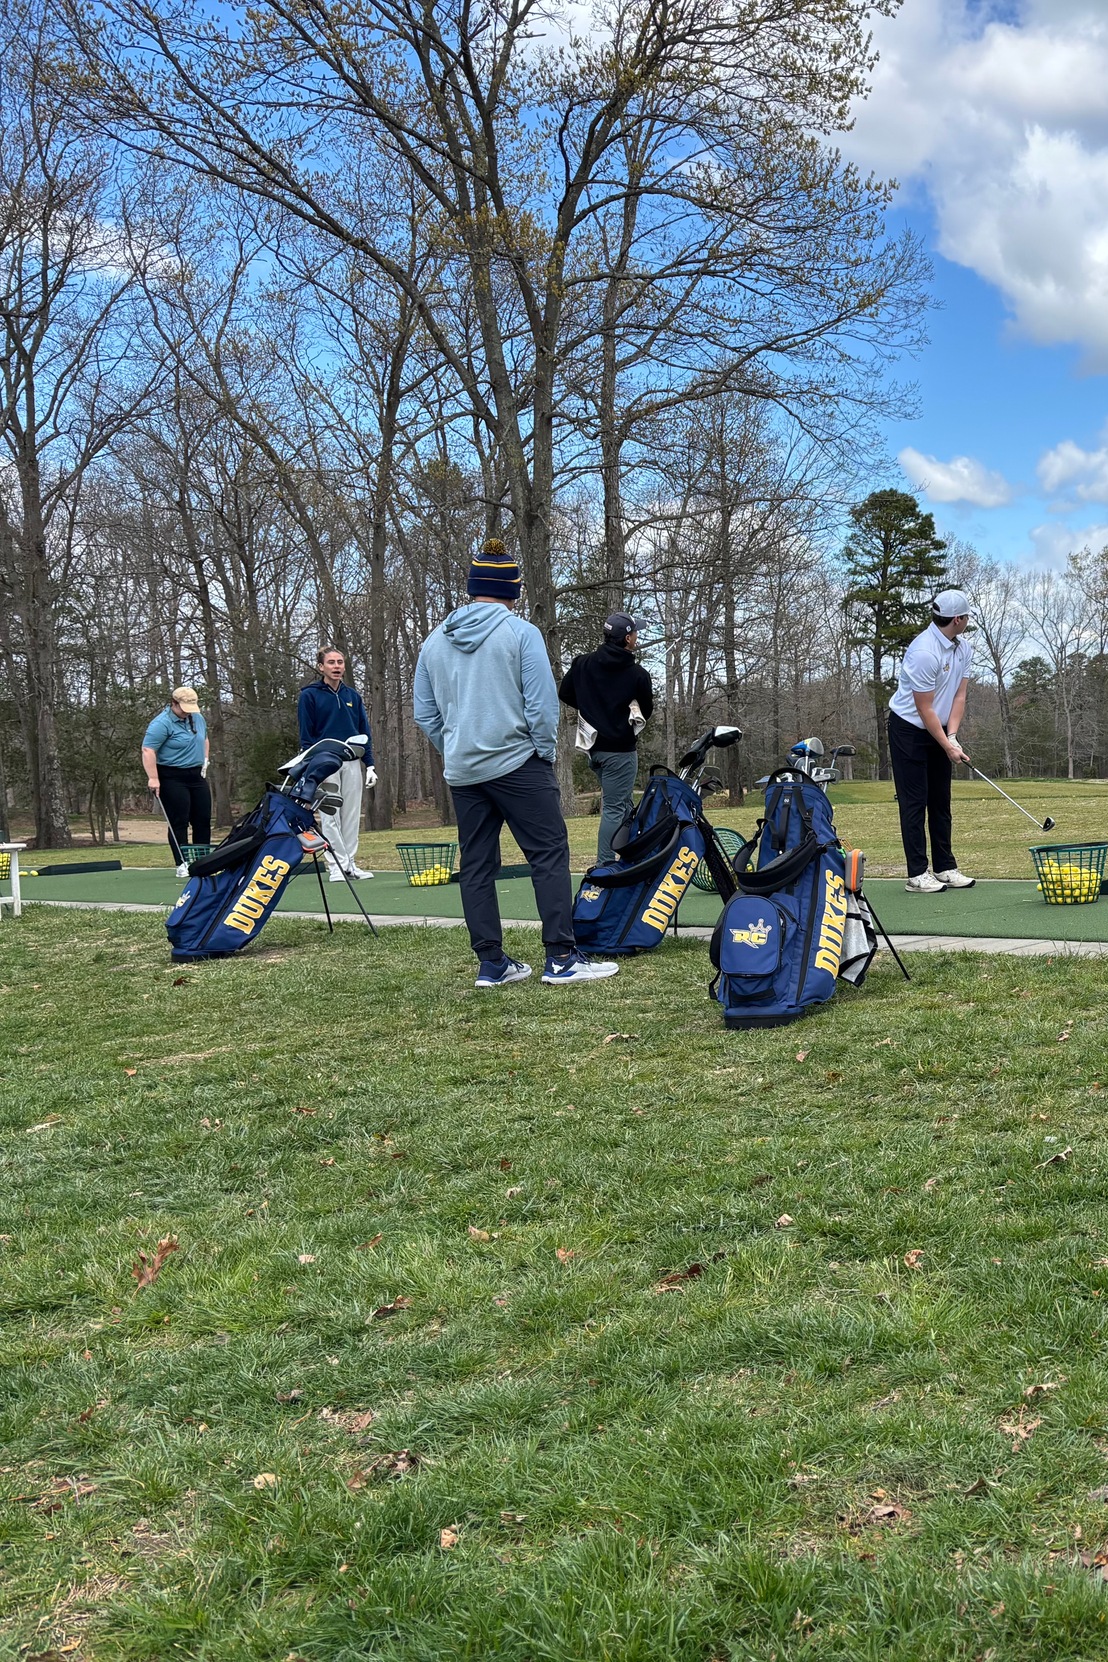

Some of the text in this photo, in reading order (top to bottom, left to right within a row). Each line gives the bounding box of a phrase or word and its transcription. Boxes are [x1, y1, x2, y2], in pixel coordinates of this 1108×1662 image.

[223, 854, 291, 935] DUKES
[641, 846, 700, 934] DUKES
[814, 869, 848, 980] DUKES
[729, 927, 769, 949] RC
